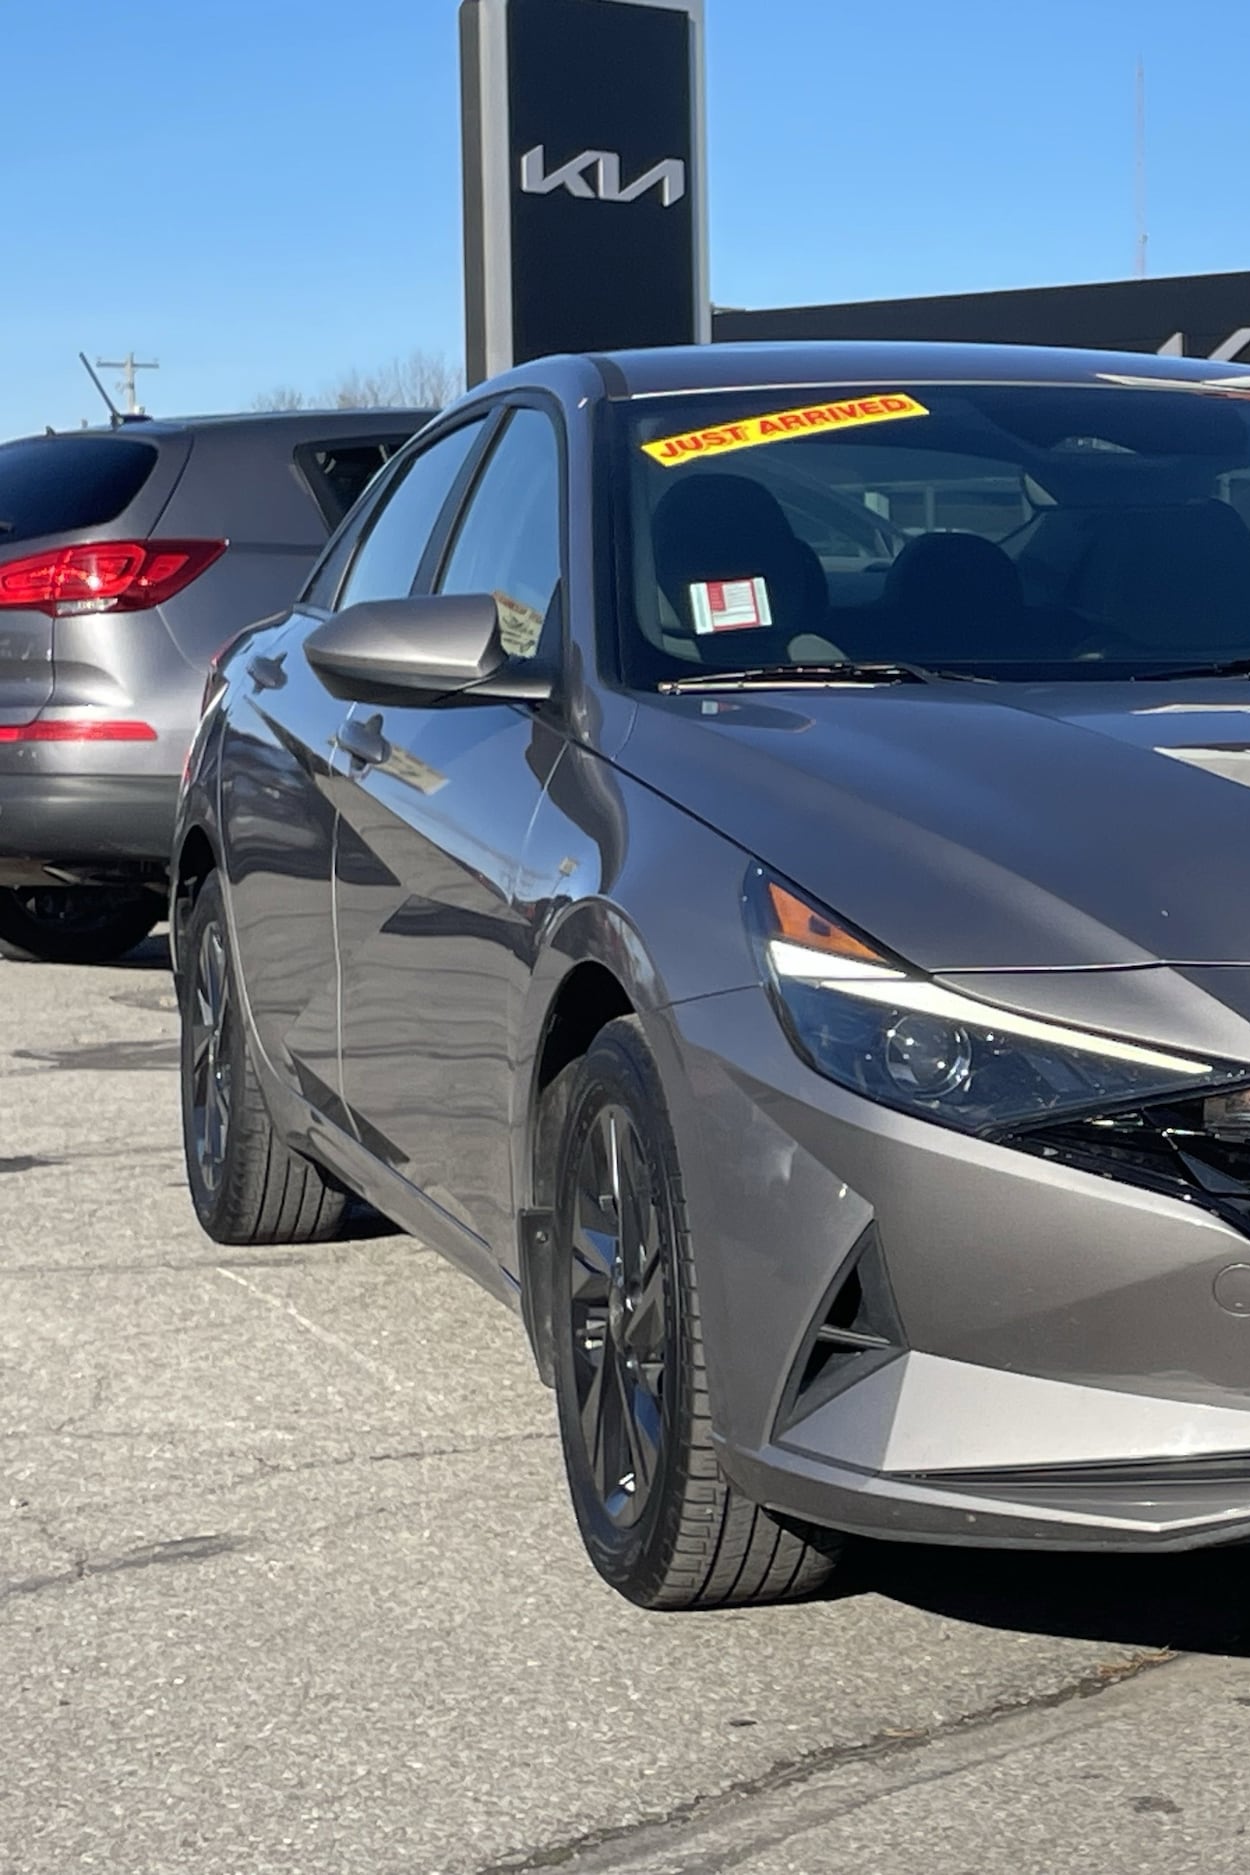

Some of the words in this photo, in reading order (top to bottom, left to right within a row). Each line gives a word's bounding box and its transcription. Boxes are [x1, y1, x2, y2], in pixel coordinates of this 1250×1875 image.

[521, 144, 686, 208] KIA
[660, 425, 749, 459] JUST
[760, 397, 915, 436] ARRIVED
